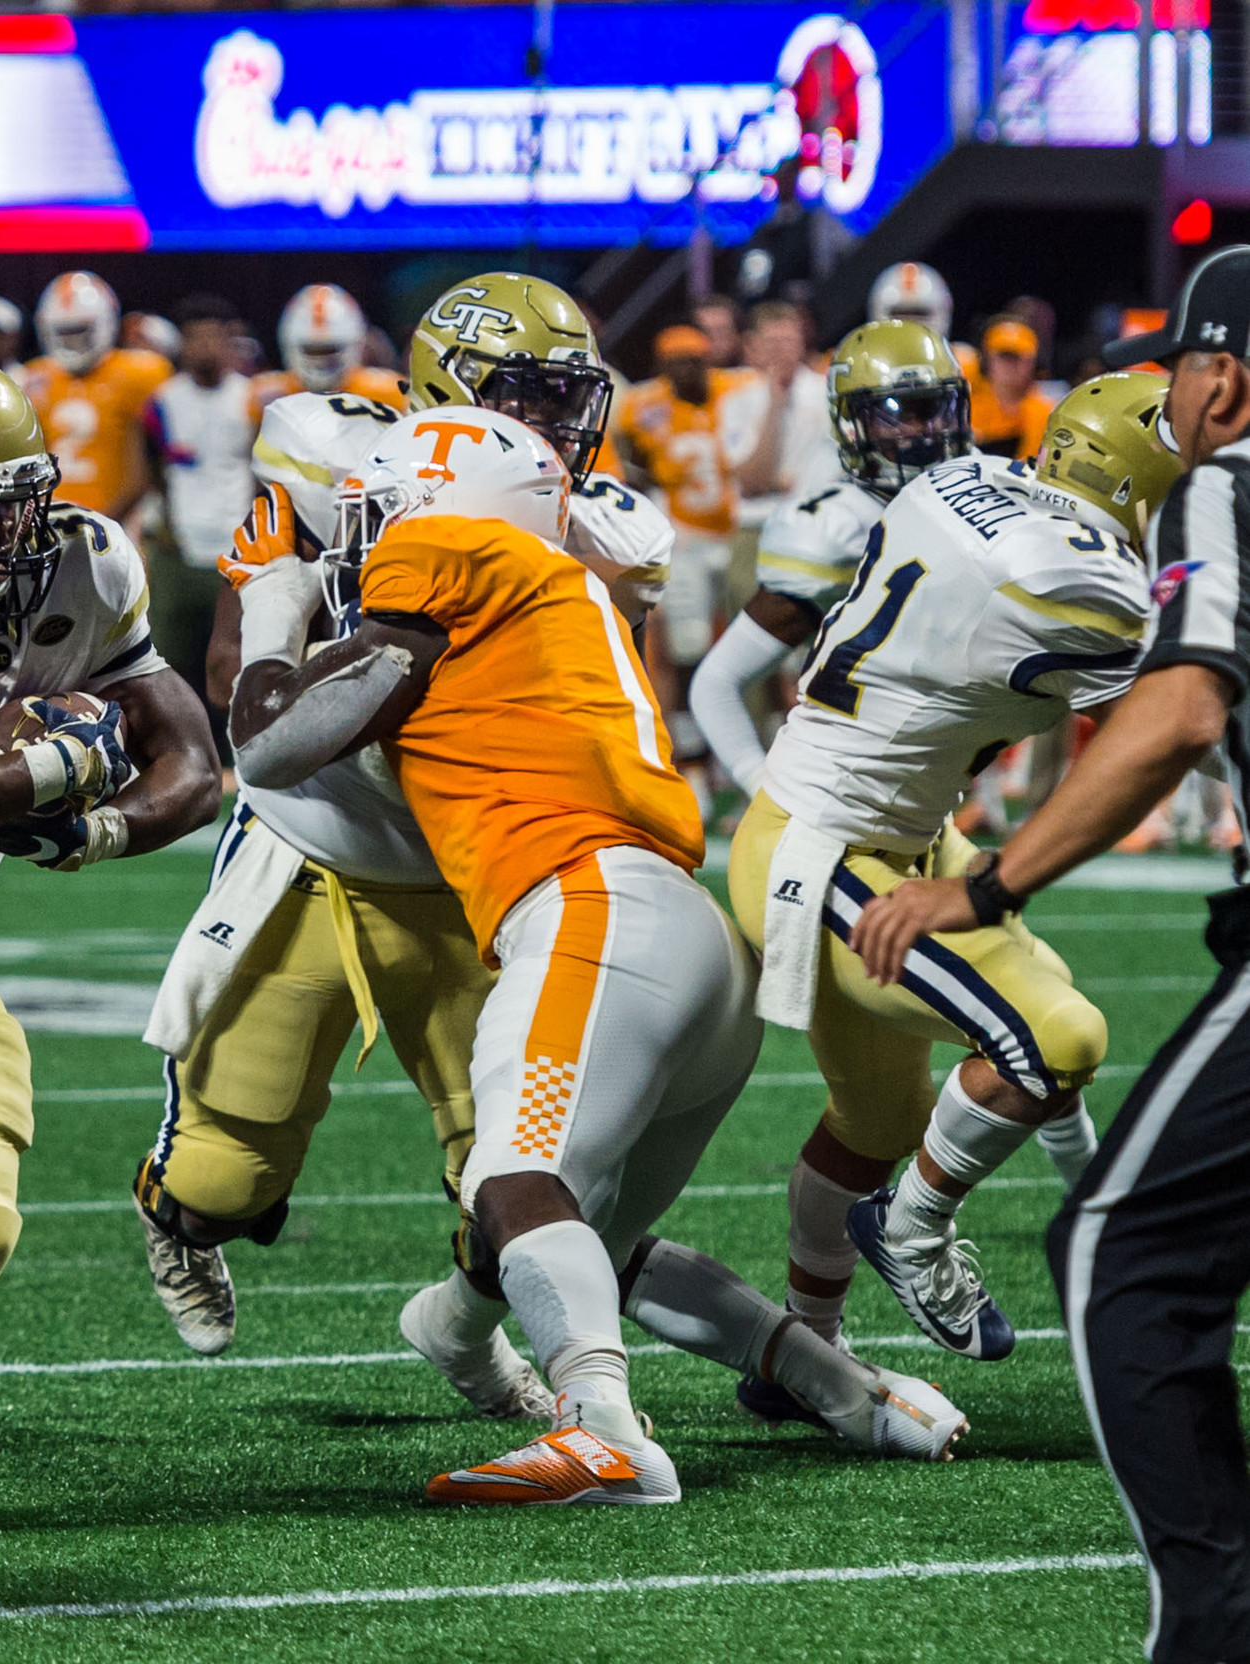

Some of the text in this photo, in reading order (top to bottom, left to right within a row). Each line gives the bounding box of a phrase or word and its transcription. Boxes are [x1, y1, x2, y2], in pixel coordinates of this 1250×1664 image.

[430, 286, 513, 343] GT
[52, 400, 98, 483] 2
[413, 421, 487, 482] T
